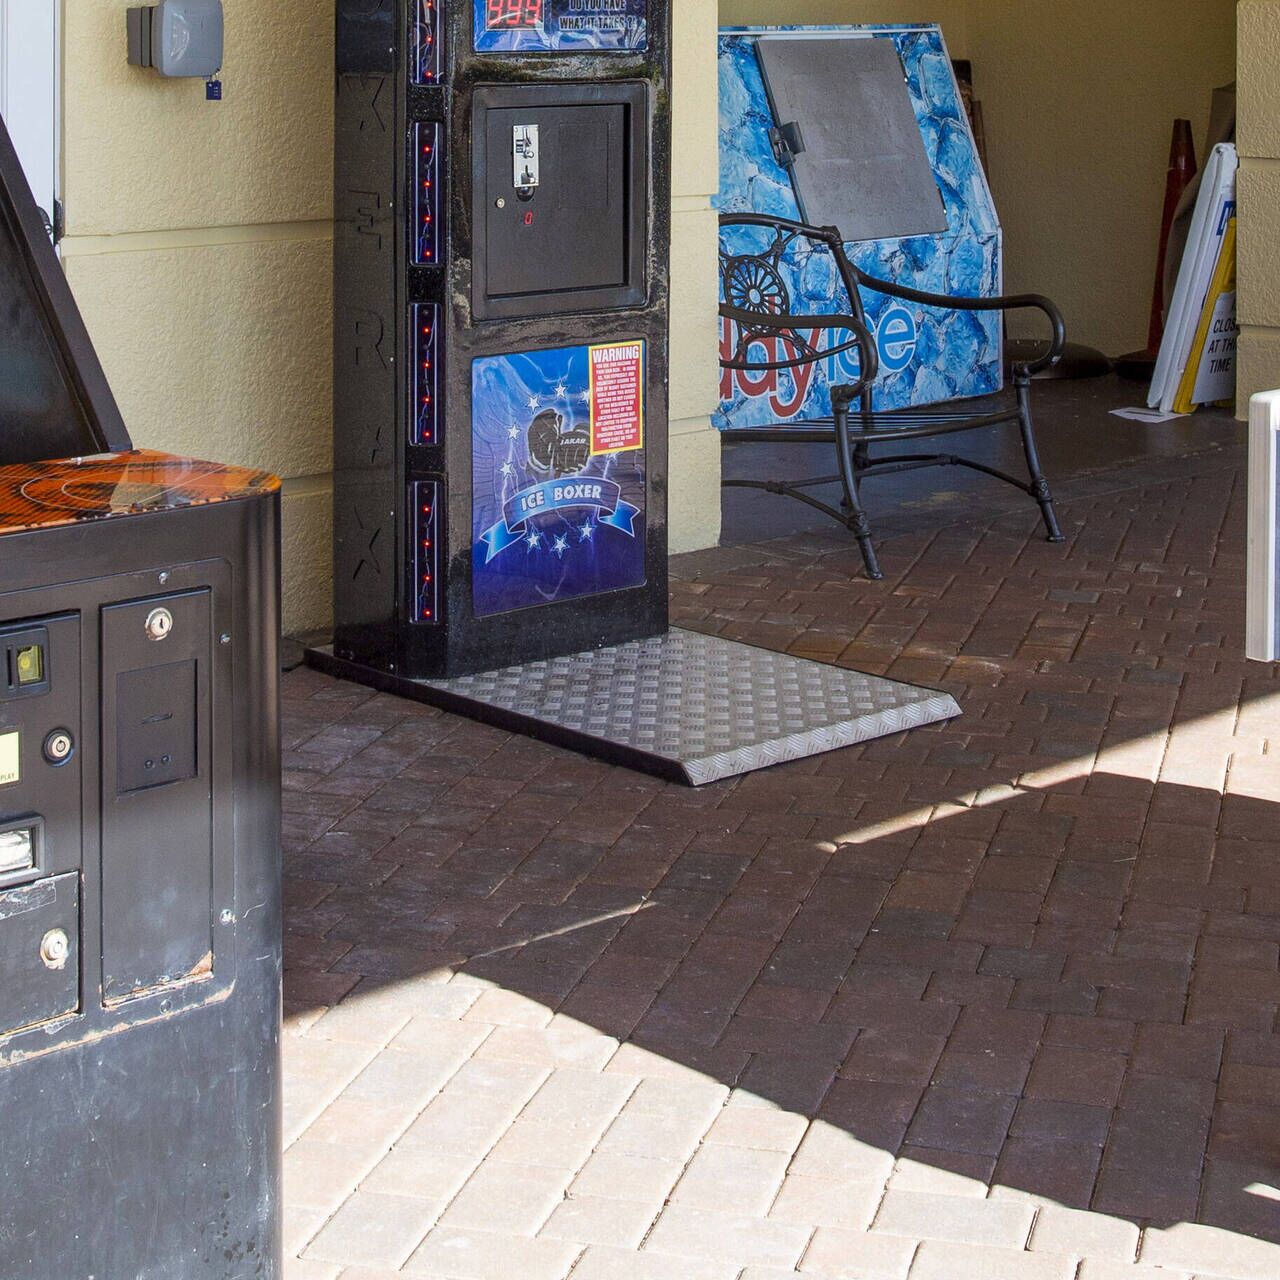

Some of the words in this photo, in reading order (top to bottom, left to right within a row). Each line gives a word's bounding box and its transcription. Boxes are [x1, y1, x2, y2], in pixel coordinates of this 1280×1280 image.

[559, 15, 585, 30] WHAT
[586, 15, 596, 30] IT
[598, 14, 625, 30] TAKES
[592, 345, 640, 363] WARNING
[1208, 339, 1221, 354] AT
[1210, 357, 1232, 373] TIME
[521, 490, 545, 512] ICE
[554, 485, 602, 502] BOXER
[1, 772, 15, 781] PLAY
